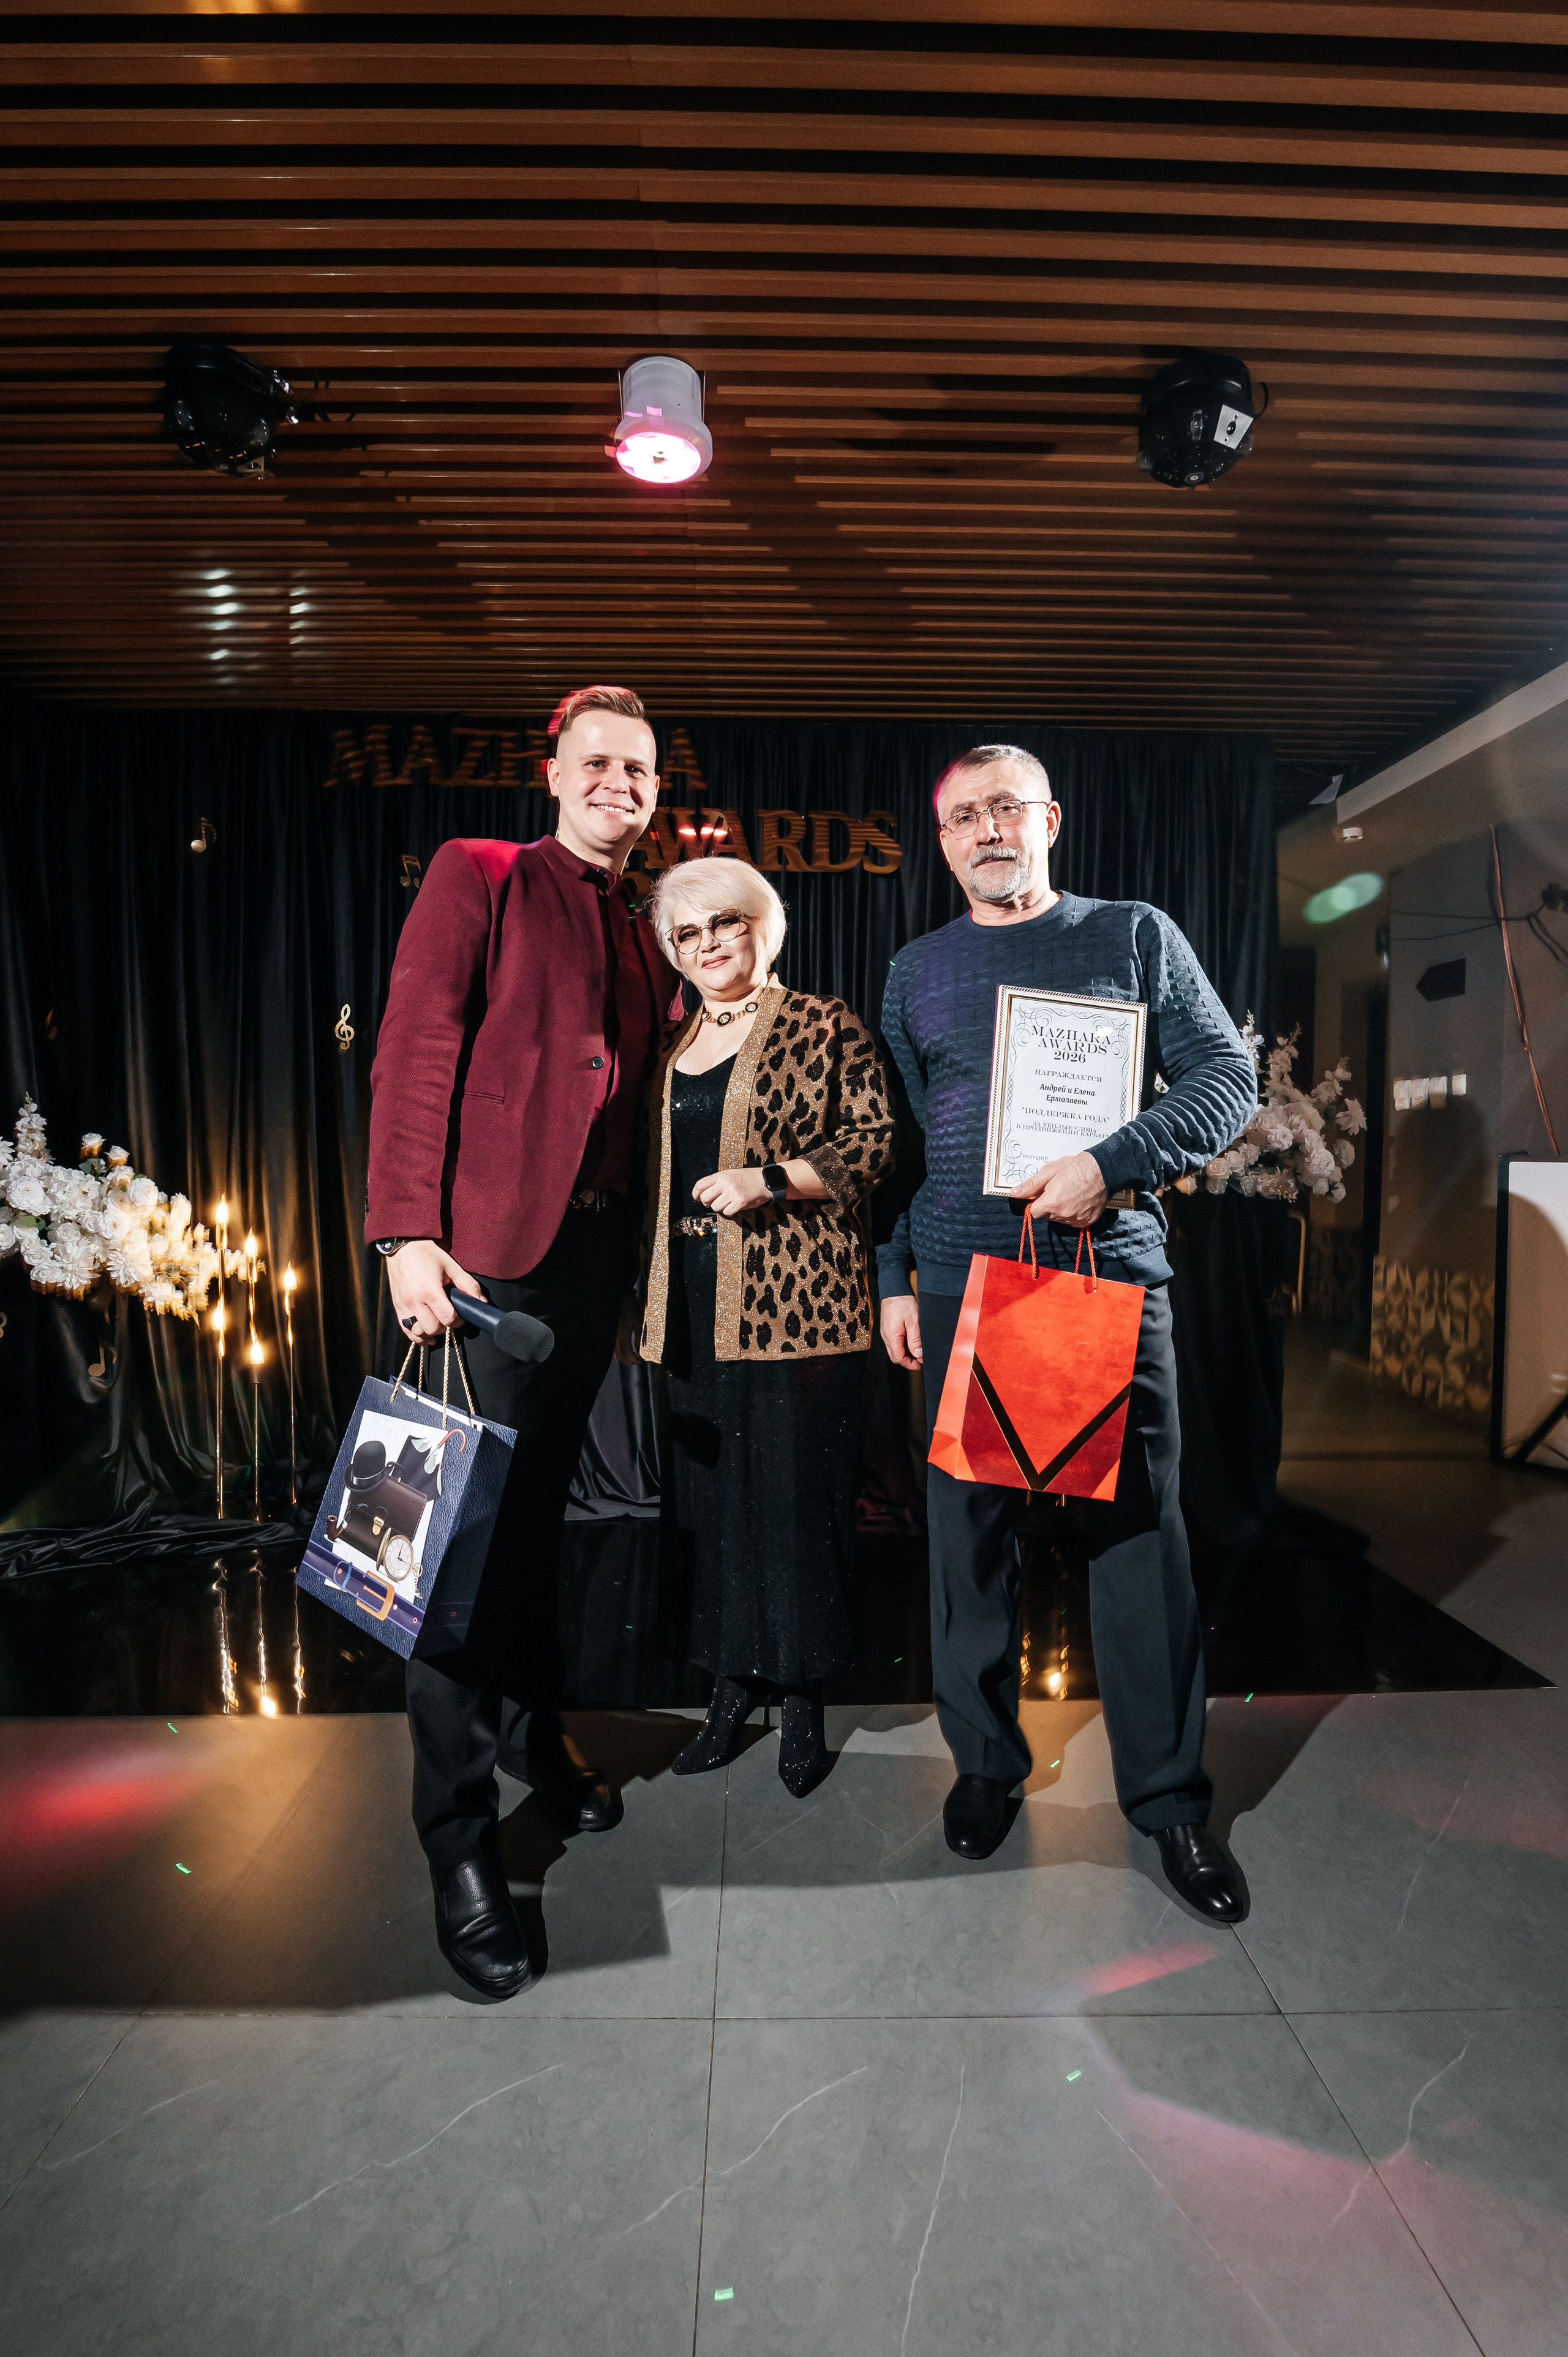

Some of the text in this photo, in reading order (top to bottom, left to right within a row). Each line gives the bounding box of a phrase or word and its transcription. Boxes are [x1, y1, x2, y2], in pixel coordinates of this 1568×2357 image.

[323, 723, 707, 791] MAZHA
[623, 806, 903, 874] AWARDS
[1031, 1025, 1111, 1045] MAZHARA
[1038, 1038, 1107, 1055] AWARDS
[1054, 1050, 1087, 1063] 2026
[1035, 1069, 1102, 1082] НАГРАЖДАЕТСЯ
[1039, 1084, 1066, 1093] Андрей
[1074, 1088, 1095, 1096] Елена
[1046, 1095, 1088, 1106] Ермолаевы
[1022, 1107, 1110, 1123] "ПОДДЕРЖКА ГОДА"
[1022, 1125, 1079, 1136] ПРОДВИЖЕНИИ
